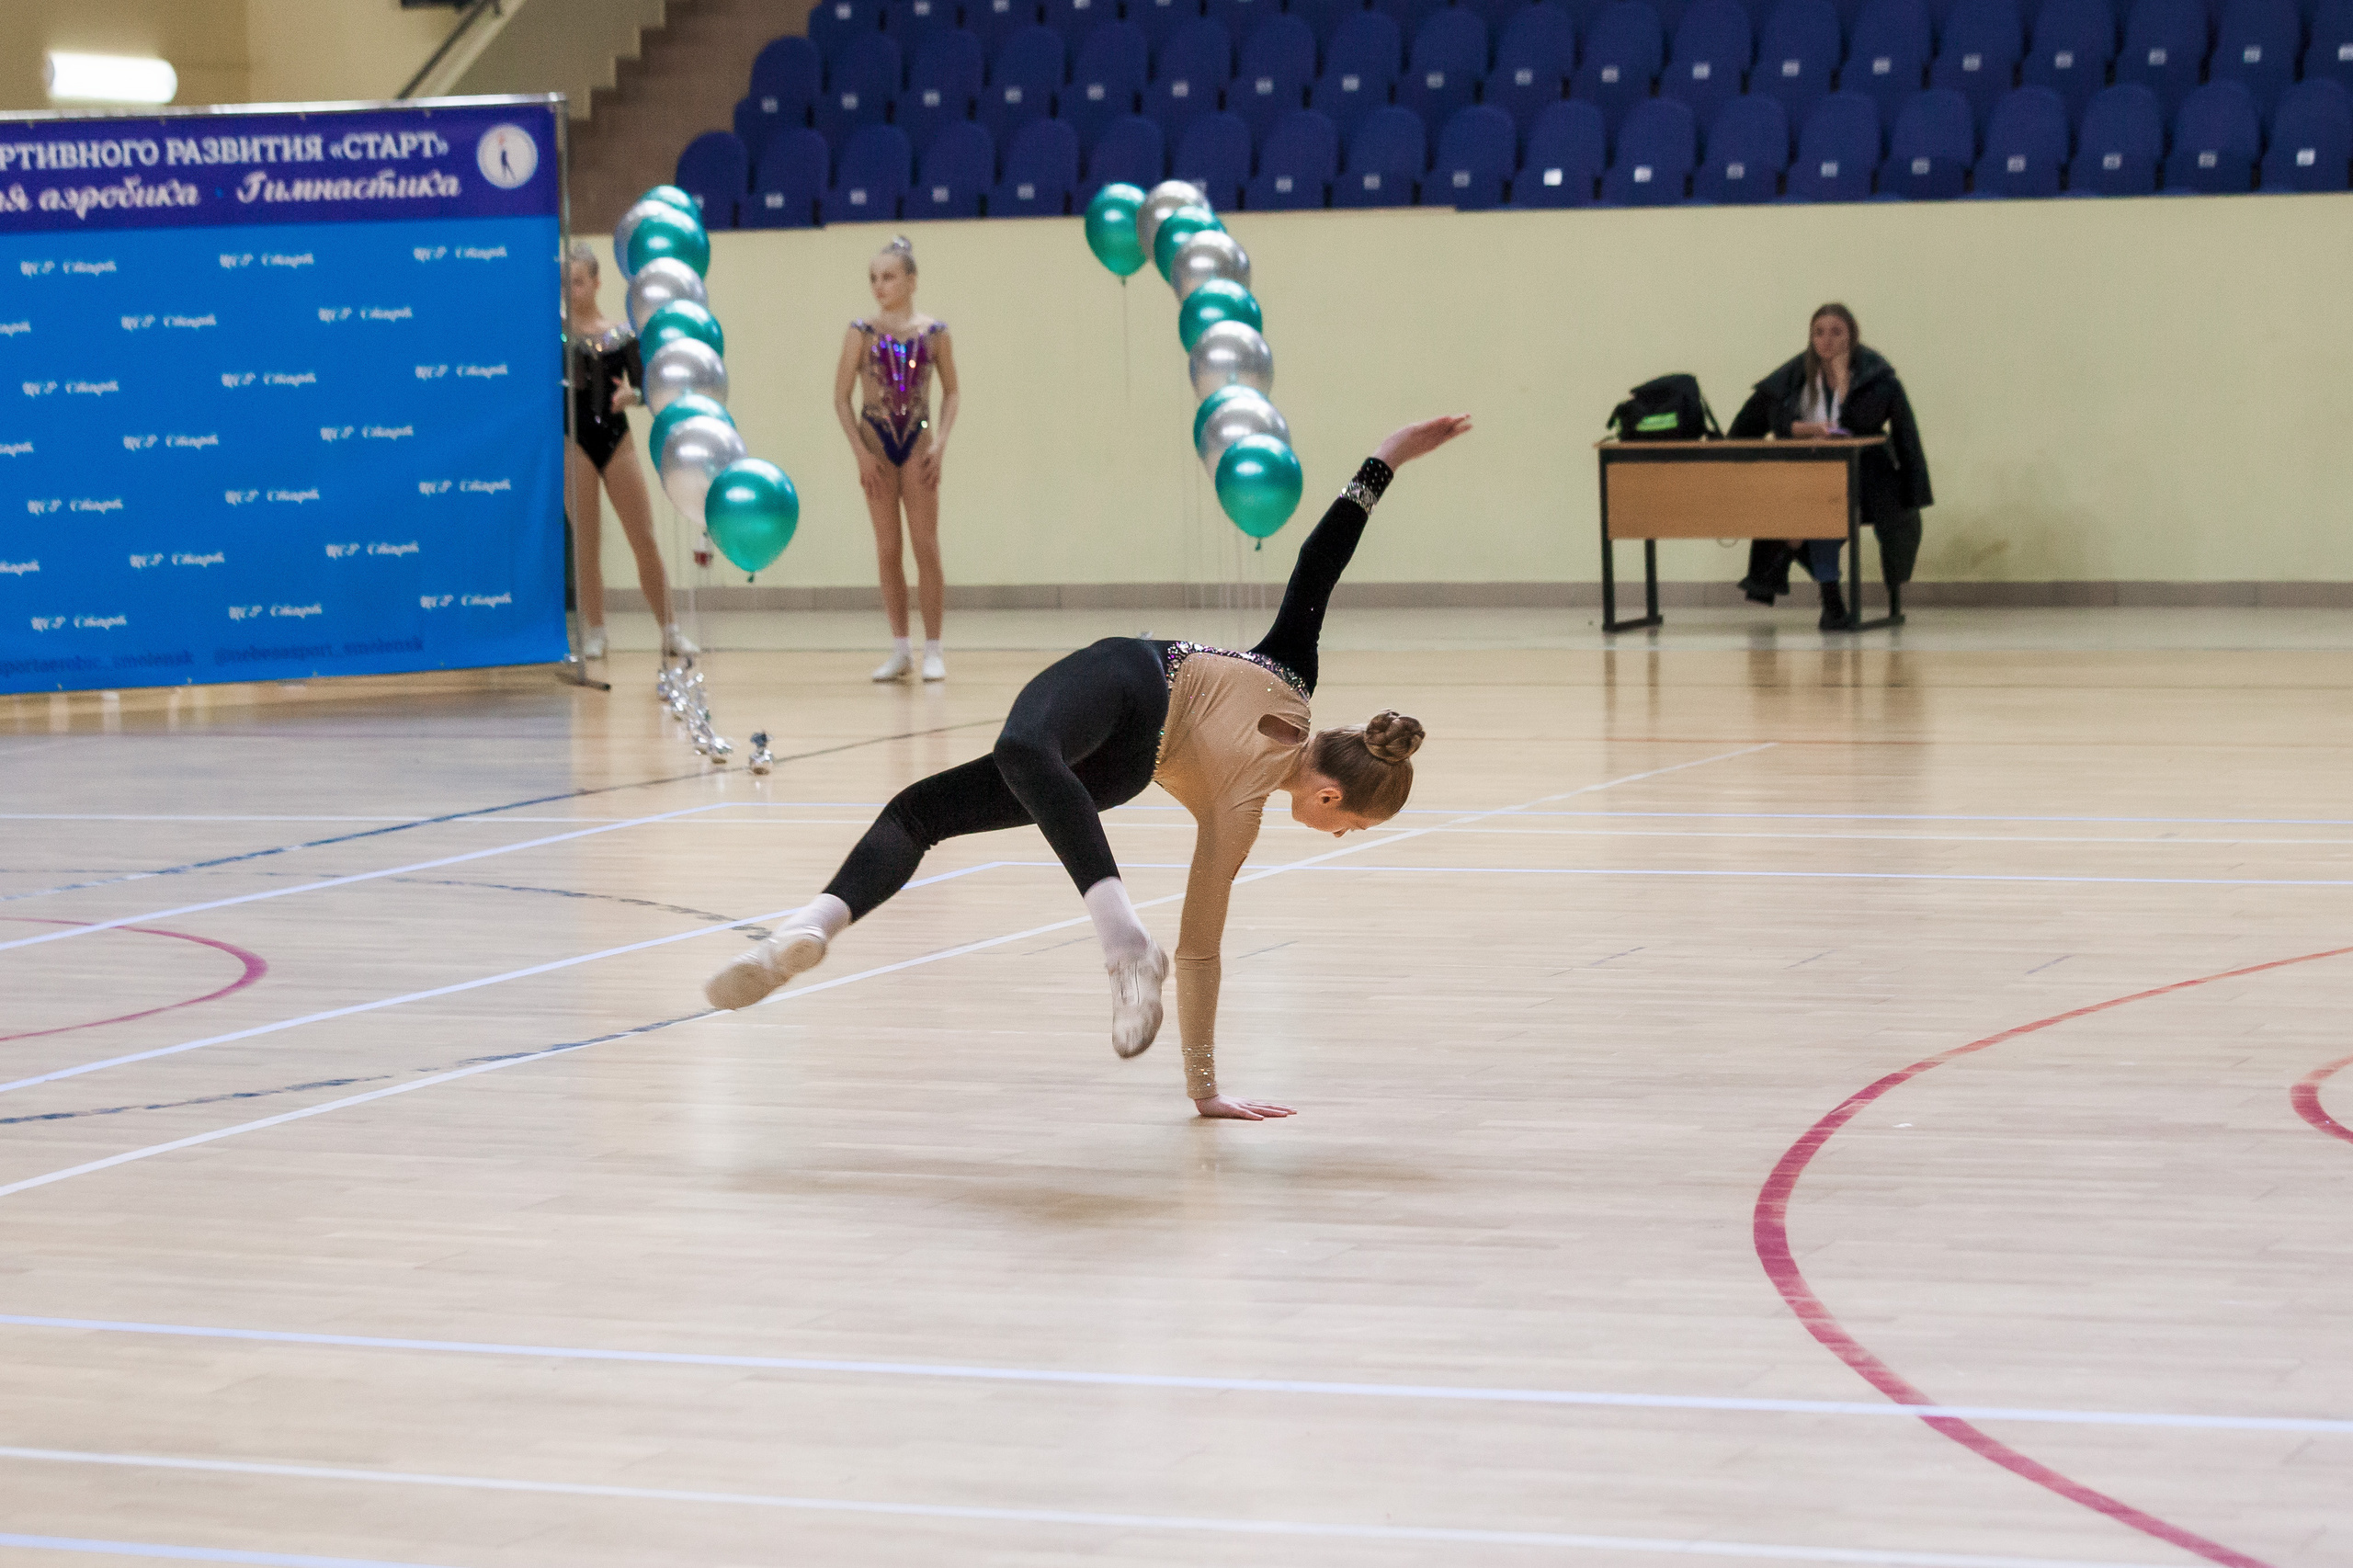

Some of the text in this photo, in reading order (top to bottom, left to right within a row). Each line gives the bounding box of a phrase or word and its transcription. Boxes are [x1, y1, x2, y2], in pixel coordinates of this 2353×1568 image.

[0, 131, 450, 170] РТИВНОГО РАЗВИТИЯ «СТАРТ»
[38, 175, 200, 221] аэробика
[236, 167, 460, 204] Гимнастика
